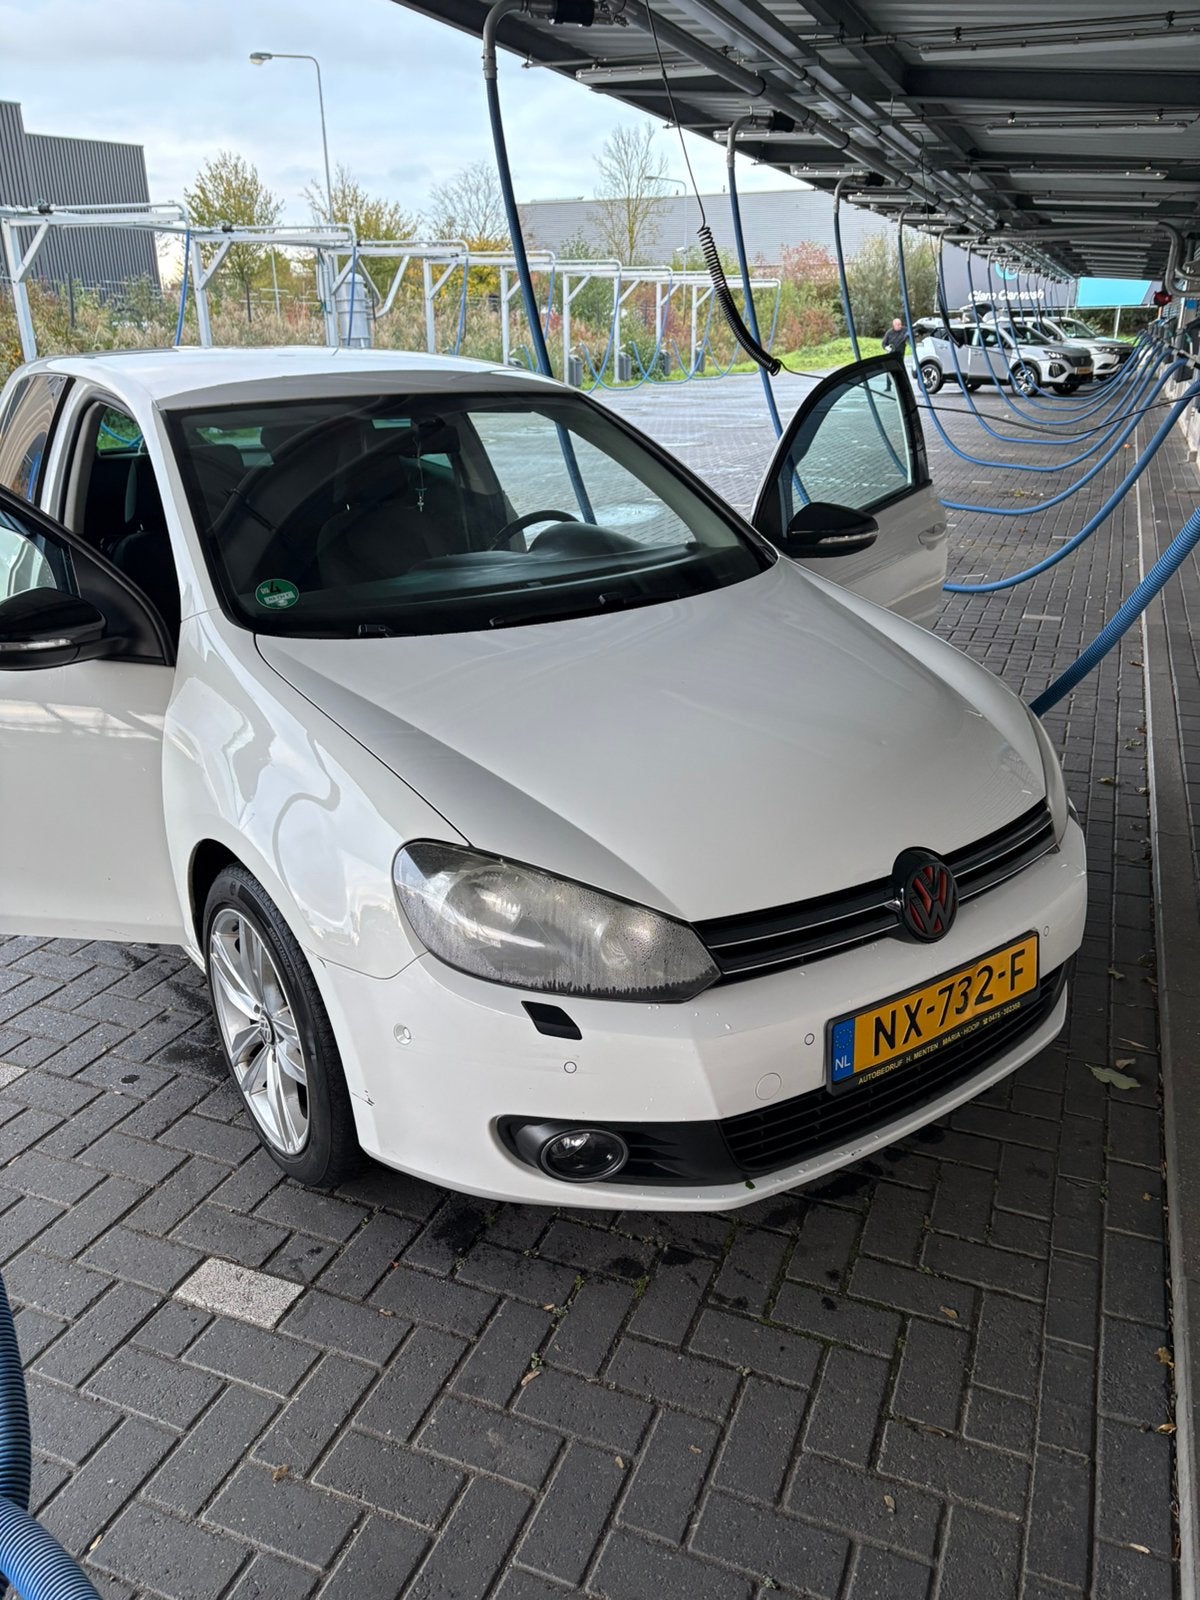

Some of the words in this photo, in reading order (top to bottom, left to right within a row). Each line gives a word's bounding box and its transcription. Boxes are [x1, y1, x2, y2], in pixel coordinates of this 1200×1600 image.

[873, 948, 1026, 1057] NX-732-F
[835, 1058, 851, 1071] NL
[857, 1058, 903, 1086] AUTOBEDRIJF
[913, 1042, 939, 1060] MENTEN
